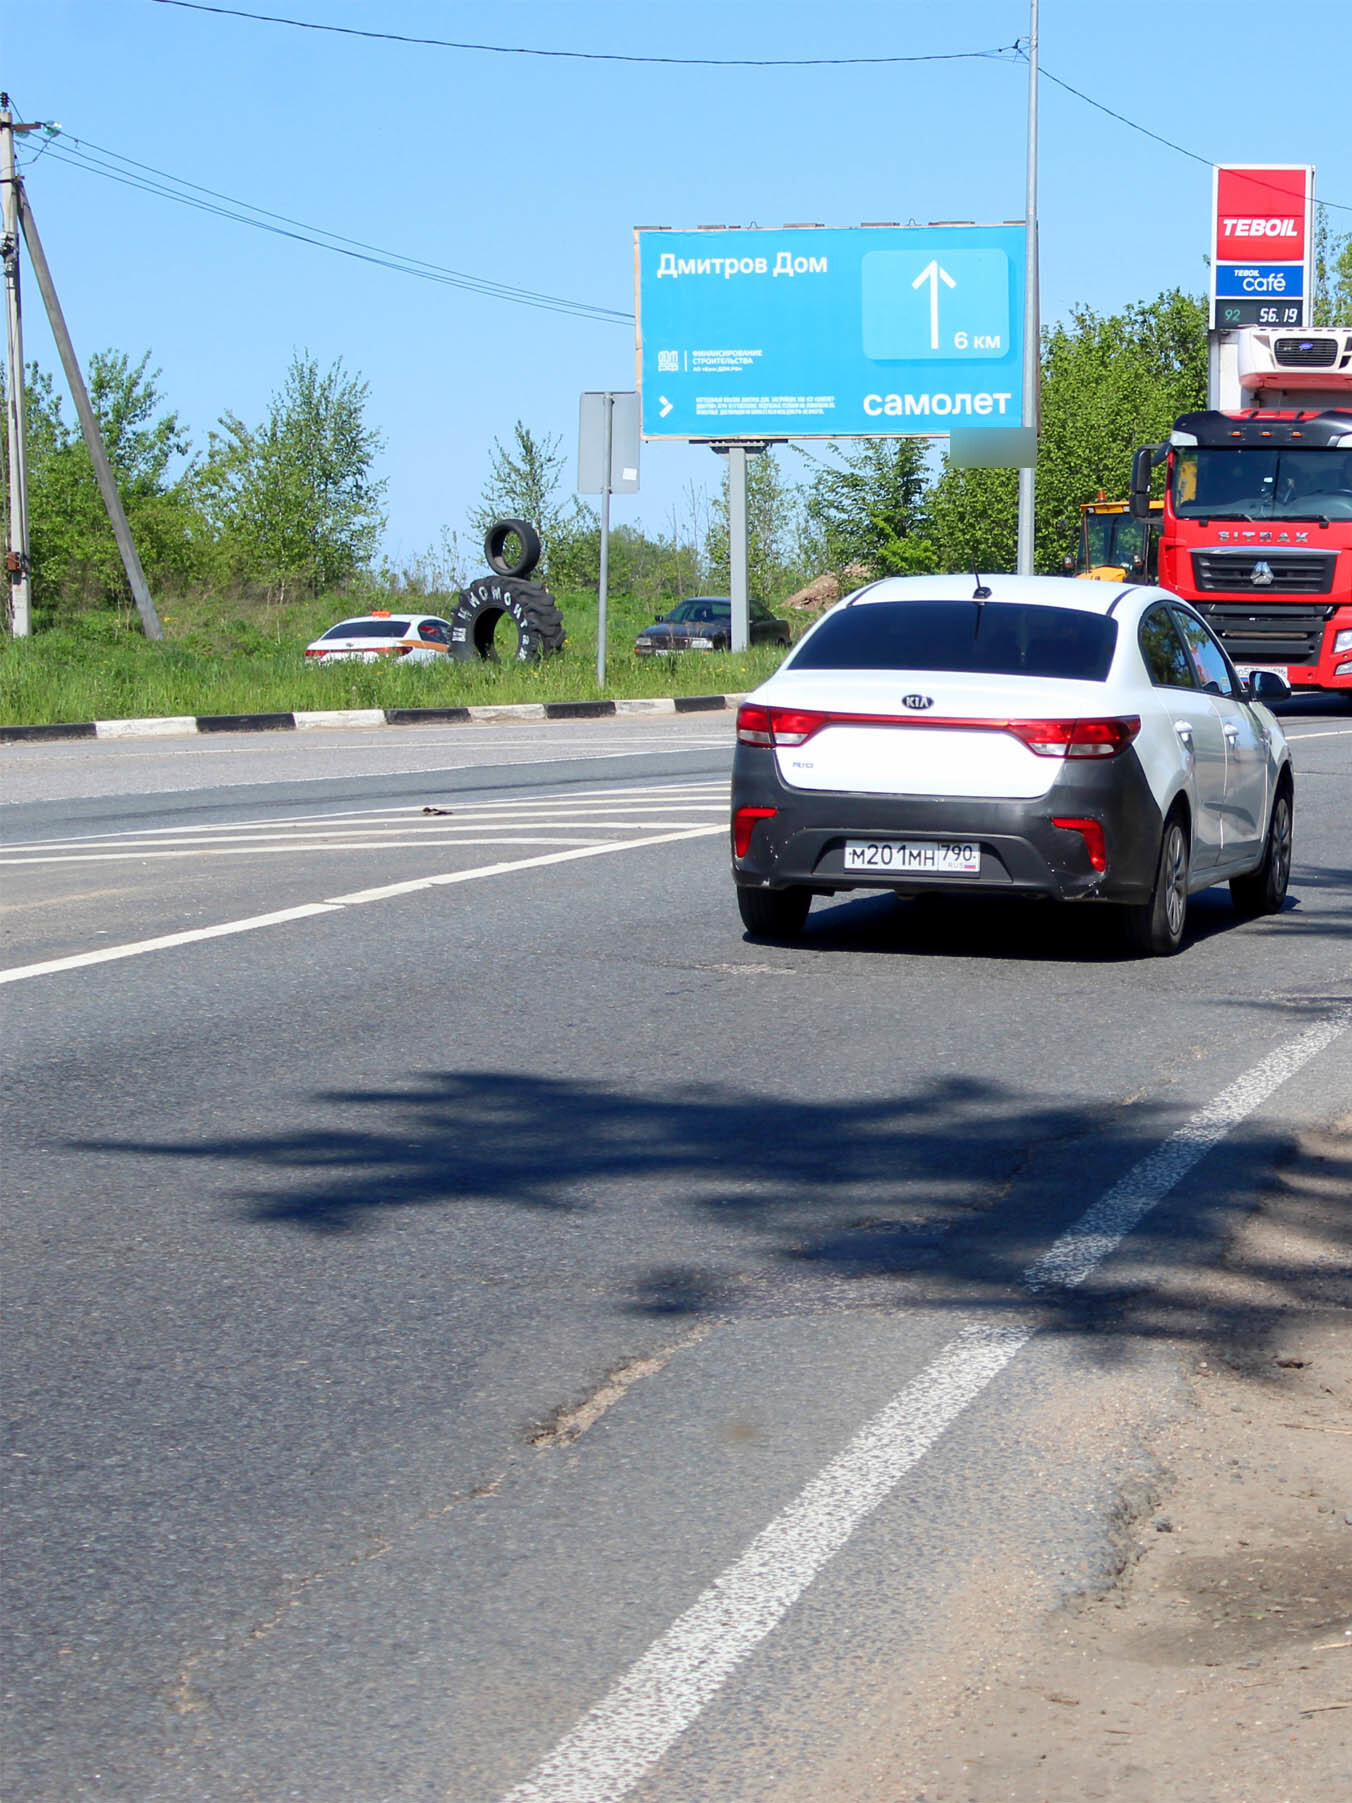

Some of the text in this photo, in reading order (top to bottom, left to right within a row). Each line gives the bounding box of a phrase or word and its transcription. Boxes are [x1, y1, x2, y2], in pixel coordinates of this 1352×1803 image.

[1223, 219, 1298, 237] TEBOIL
[657, 251, 828, 280] Дмитров Дом
[1234, 269, 1260, 277] TEBOIL
[1242, 273, 1287, 292] café
[1224, 309, 1241, 321] 92
[954, 333, 1001, 350] 6 км
[863, 391, 1012, 417] самолет
[1218, 531, 1309, 543] SITRAK
[905, 696, 930, 708] KIA
[851, 843, 973, 868] М201МН 790
